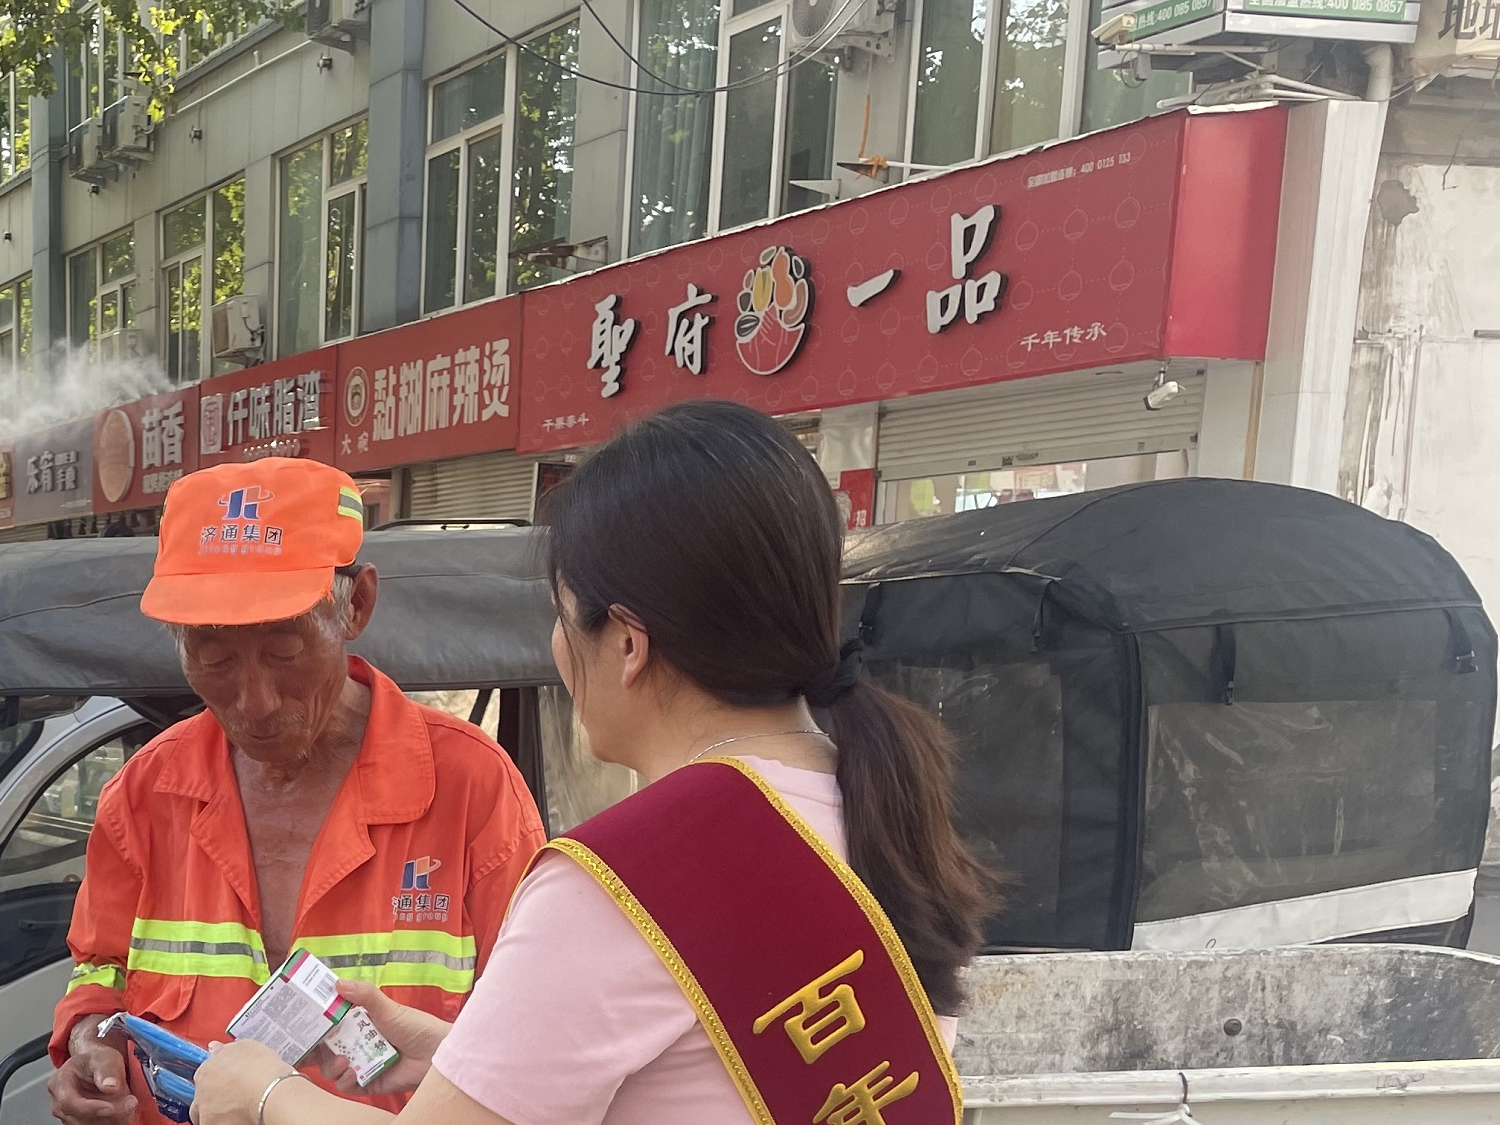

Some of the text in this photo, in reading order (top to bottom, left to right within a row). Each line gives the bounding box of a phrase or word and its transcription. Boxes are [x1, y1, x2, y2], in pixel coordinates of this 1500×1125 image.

[1097, 155, 1115, 170] 0125
[1118, 152, 1131, 165] 133
[847, 204, 1003, 335] 一品
[1019, 321, 1108, 352] 千年传承
[200, 524, 284, 546] 济通集团
